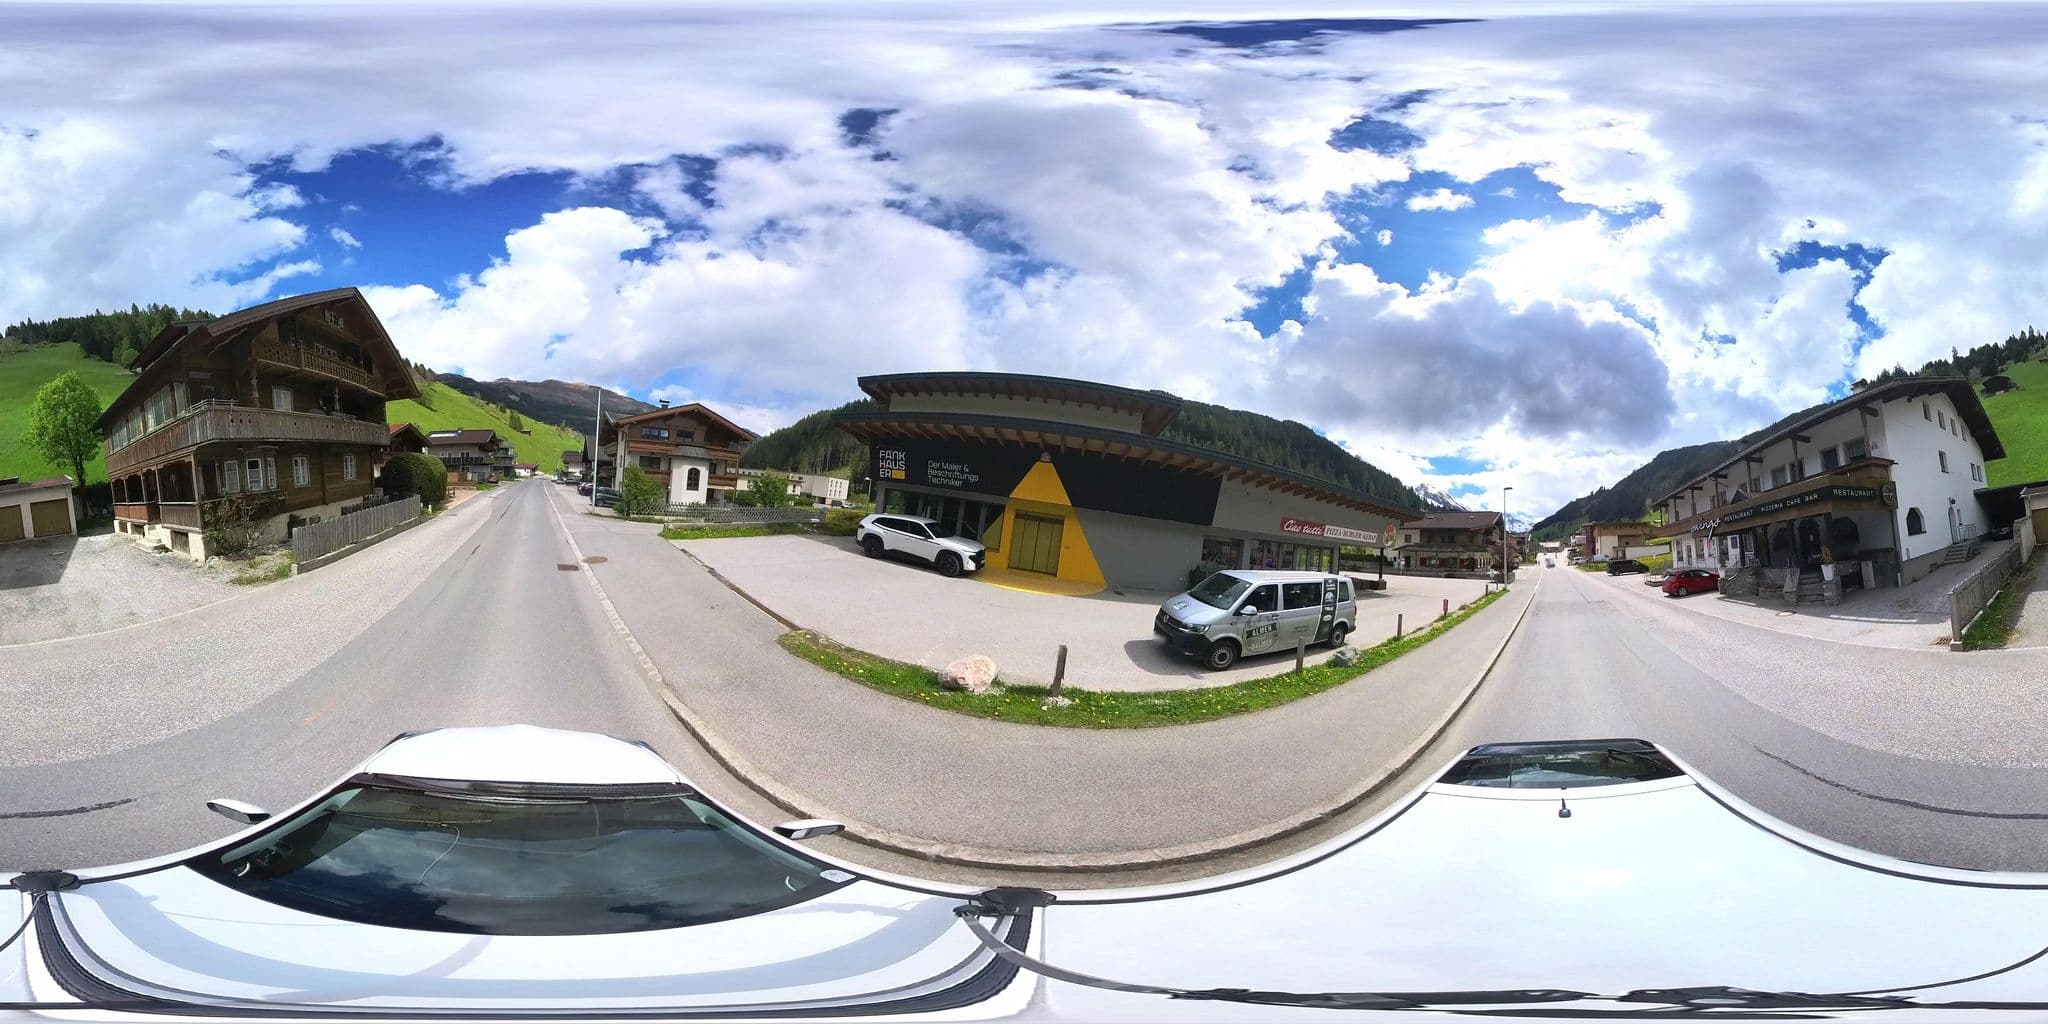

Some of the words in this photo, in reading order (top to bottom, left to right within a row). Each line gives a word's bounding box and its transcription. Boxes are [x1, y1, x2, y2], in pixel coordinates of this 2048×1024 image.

[880, 460, 906, 470] HAUS
[928, 460, 940, 468] Der
[942, 462, 962, 472] Maler
[879, 469, 892, 478] ER
[927, 467, 979, 482] Beschriftungs
[927, 475, 963, 487] Techniker
[1832, 489, 1874, 497] RESTAURANT
[1724, 510, 1752, 521] RESTAURANT
[1761, 503, 1783, 512] PIZZERIA
[1804, 493, 1818, 502] BAR
[1284, 520, 1302, 532] Ciao
[1302, 526, 1324, 536] tutti
[1252, 624, 1272, 637] ALMEN
